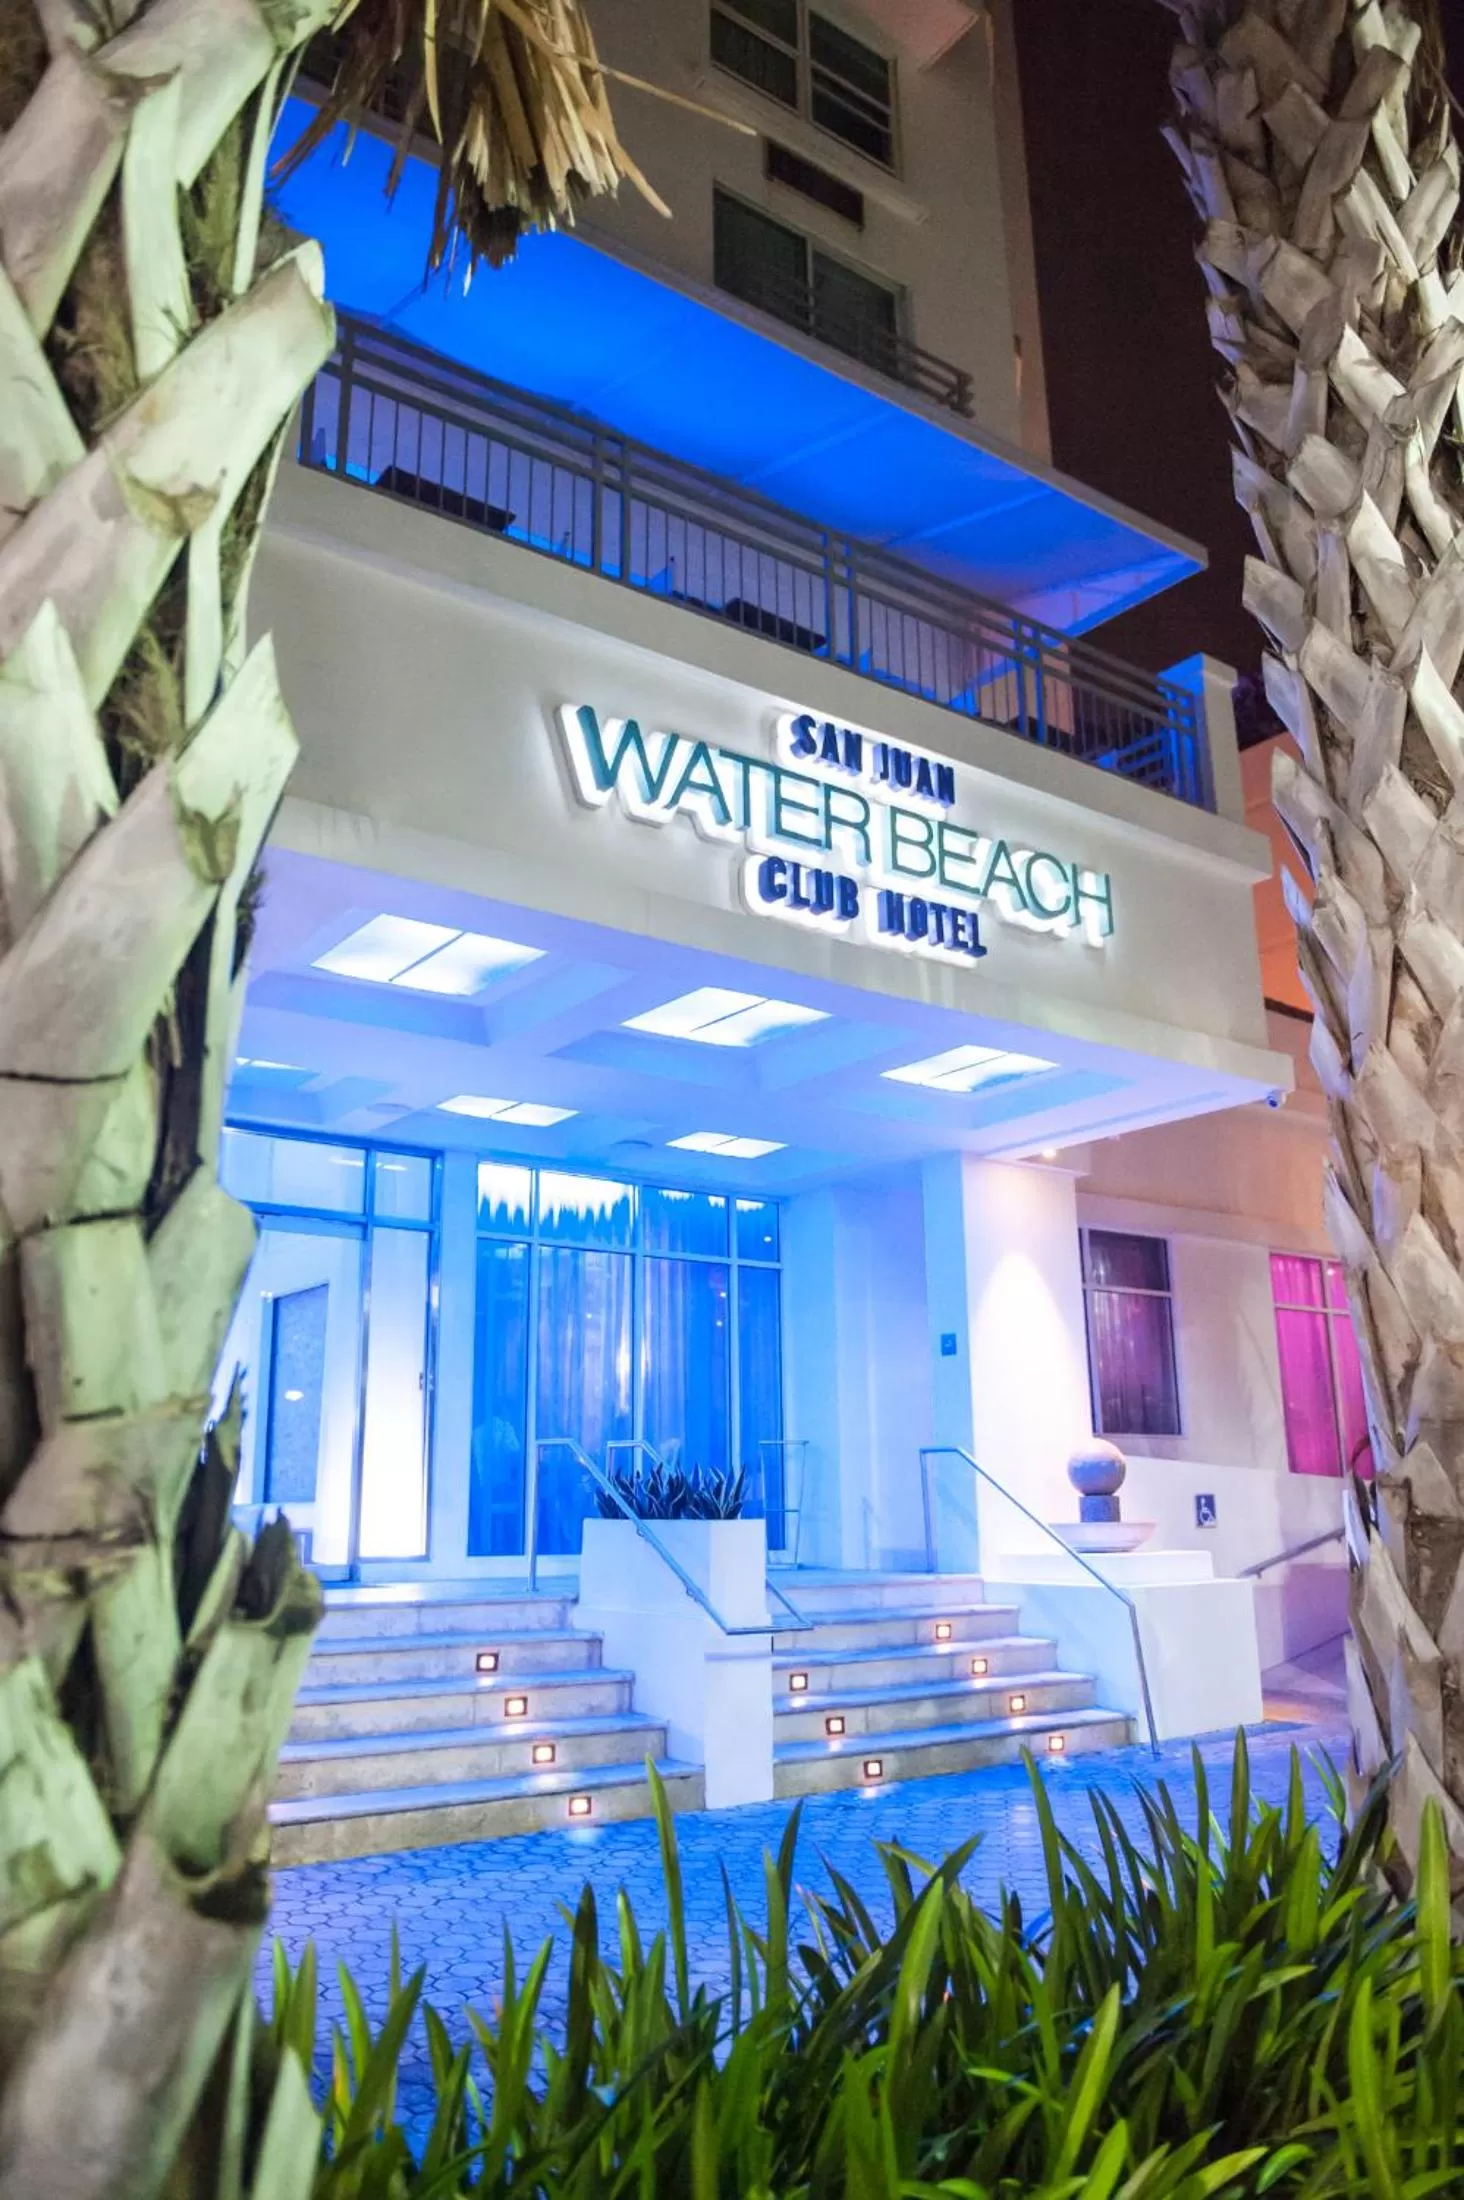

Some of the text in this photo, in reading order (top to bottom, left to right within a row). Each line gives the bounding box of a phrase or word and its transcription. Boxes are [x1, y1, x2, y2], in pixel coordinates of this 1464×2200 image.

[789, 714, 956, 807] SAN JUAN
[575, 704, 1114, 939] WATER BEACH
[758, 855, 988, 959] CLUB HOTEL
